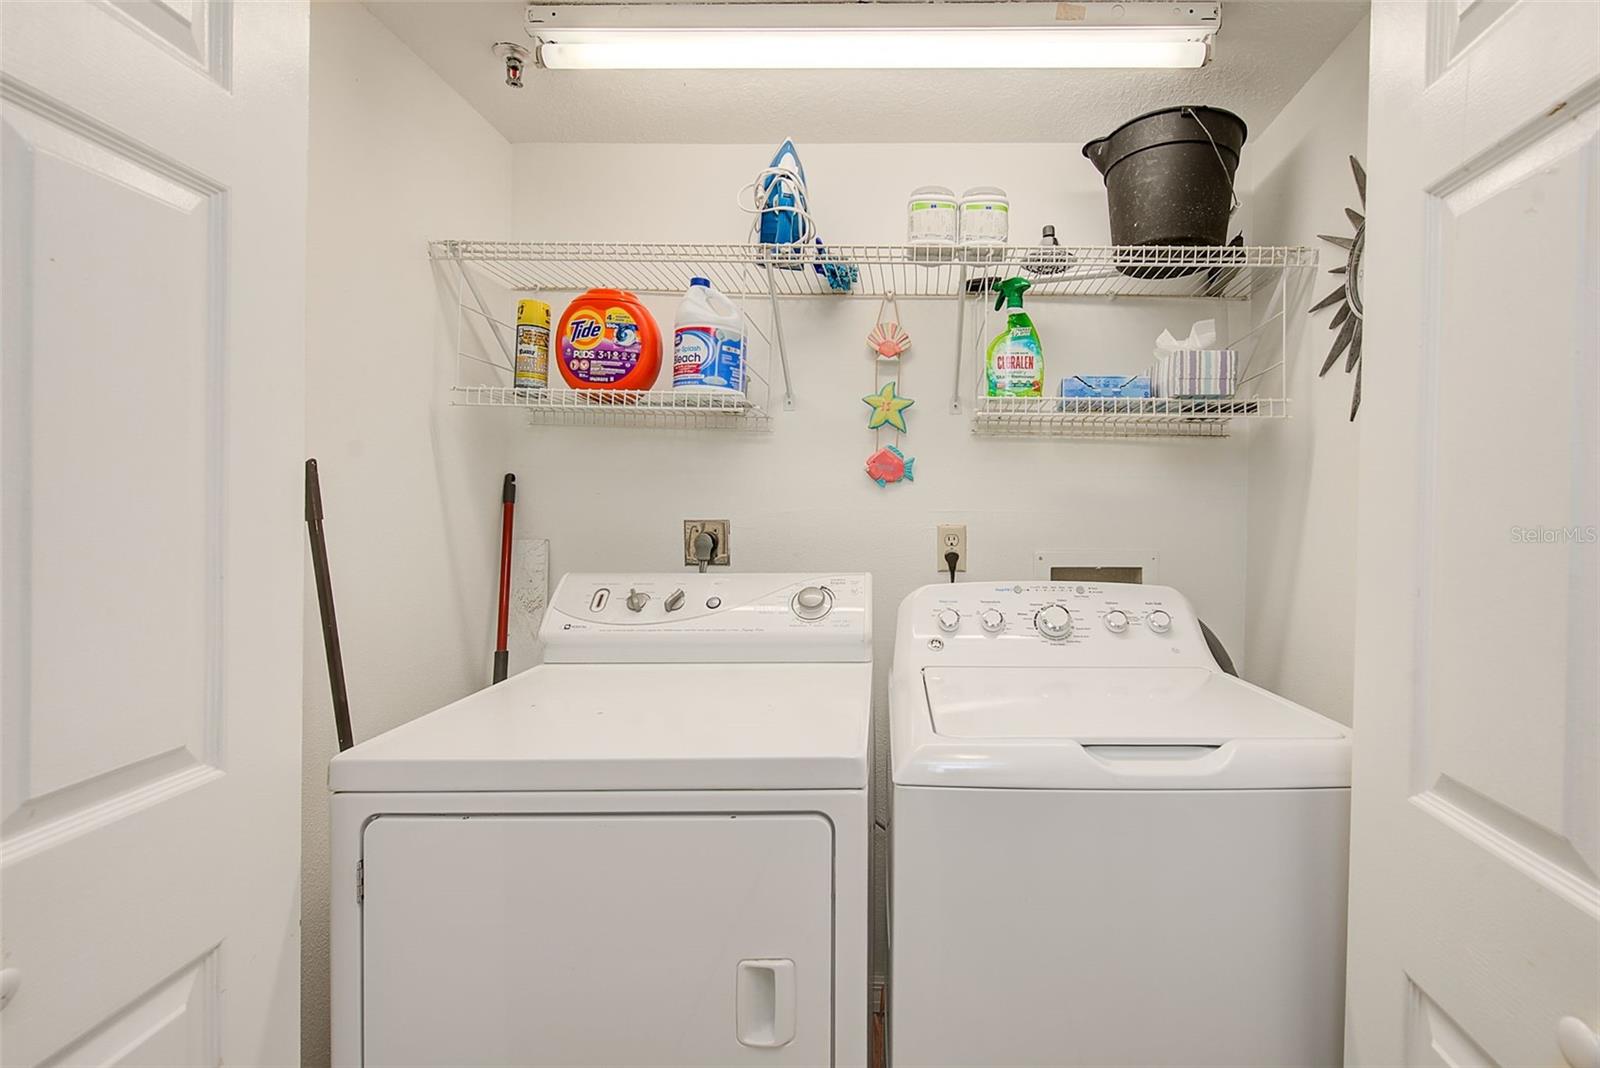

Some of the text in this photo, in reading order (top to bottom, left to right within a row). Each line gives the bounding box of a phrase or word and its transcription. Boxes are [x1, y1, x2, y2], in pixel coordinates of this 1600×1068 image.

[571, 320, 601, 343] Tide
[573, 350, 595, 359] PODS
[997, 355, 1034, 370] CLORALEN
